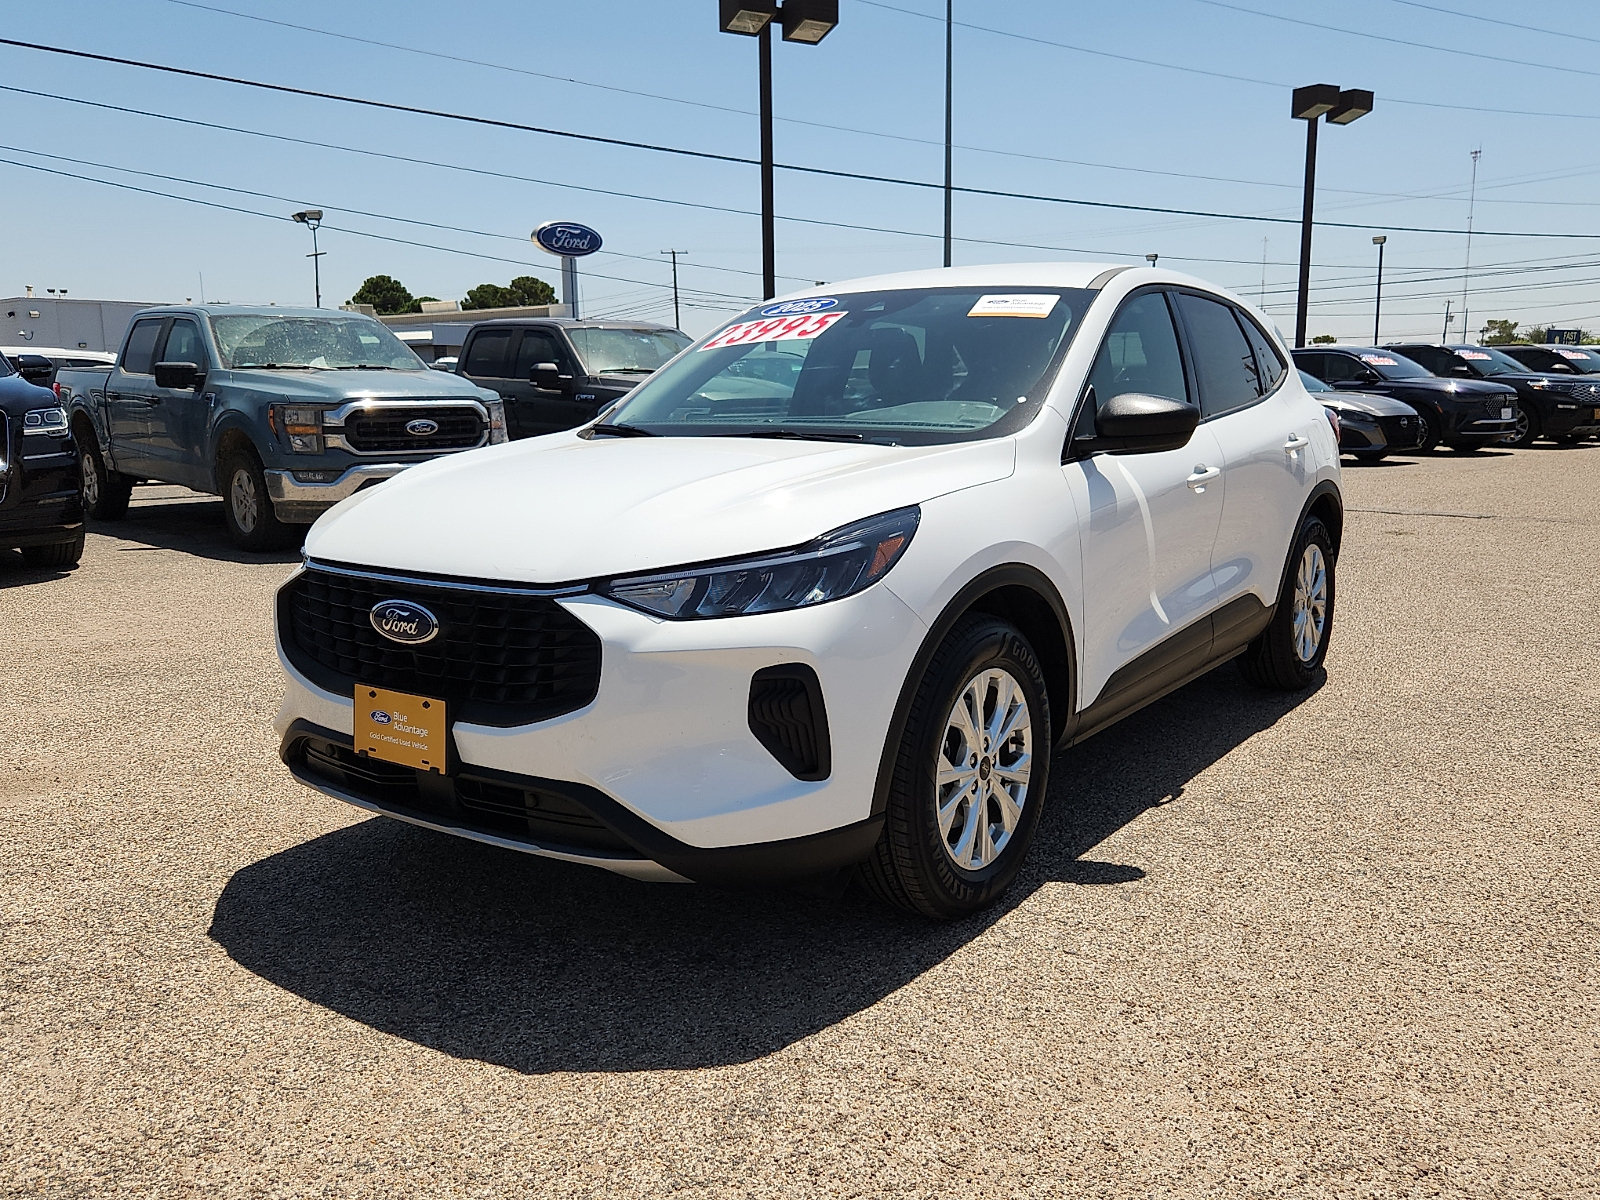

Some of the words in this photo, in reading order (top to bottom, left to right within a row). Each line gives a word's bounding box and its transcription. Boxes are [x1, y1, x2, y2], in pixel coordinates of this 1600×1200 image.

[552, 227, 591, 249] Ford
[702, 313, 843, 349] 23995
[1563, 331, 1577, 340] FAST
[382, 608, 419, 635] Ford
[374, 711, 389, 723] Ford
[393, 711, 408, 722] Blue
[393, 722, 428, 738] Advantage
[369, 731, 381, 740] Gold
[380, 734, 399, 745] Certified
[399, 738, 411, 747] Used
[411, 741, 429, 750] Vehicle
